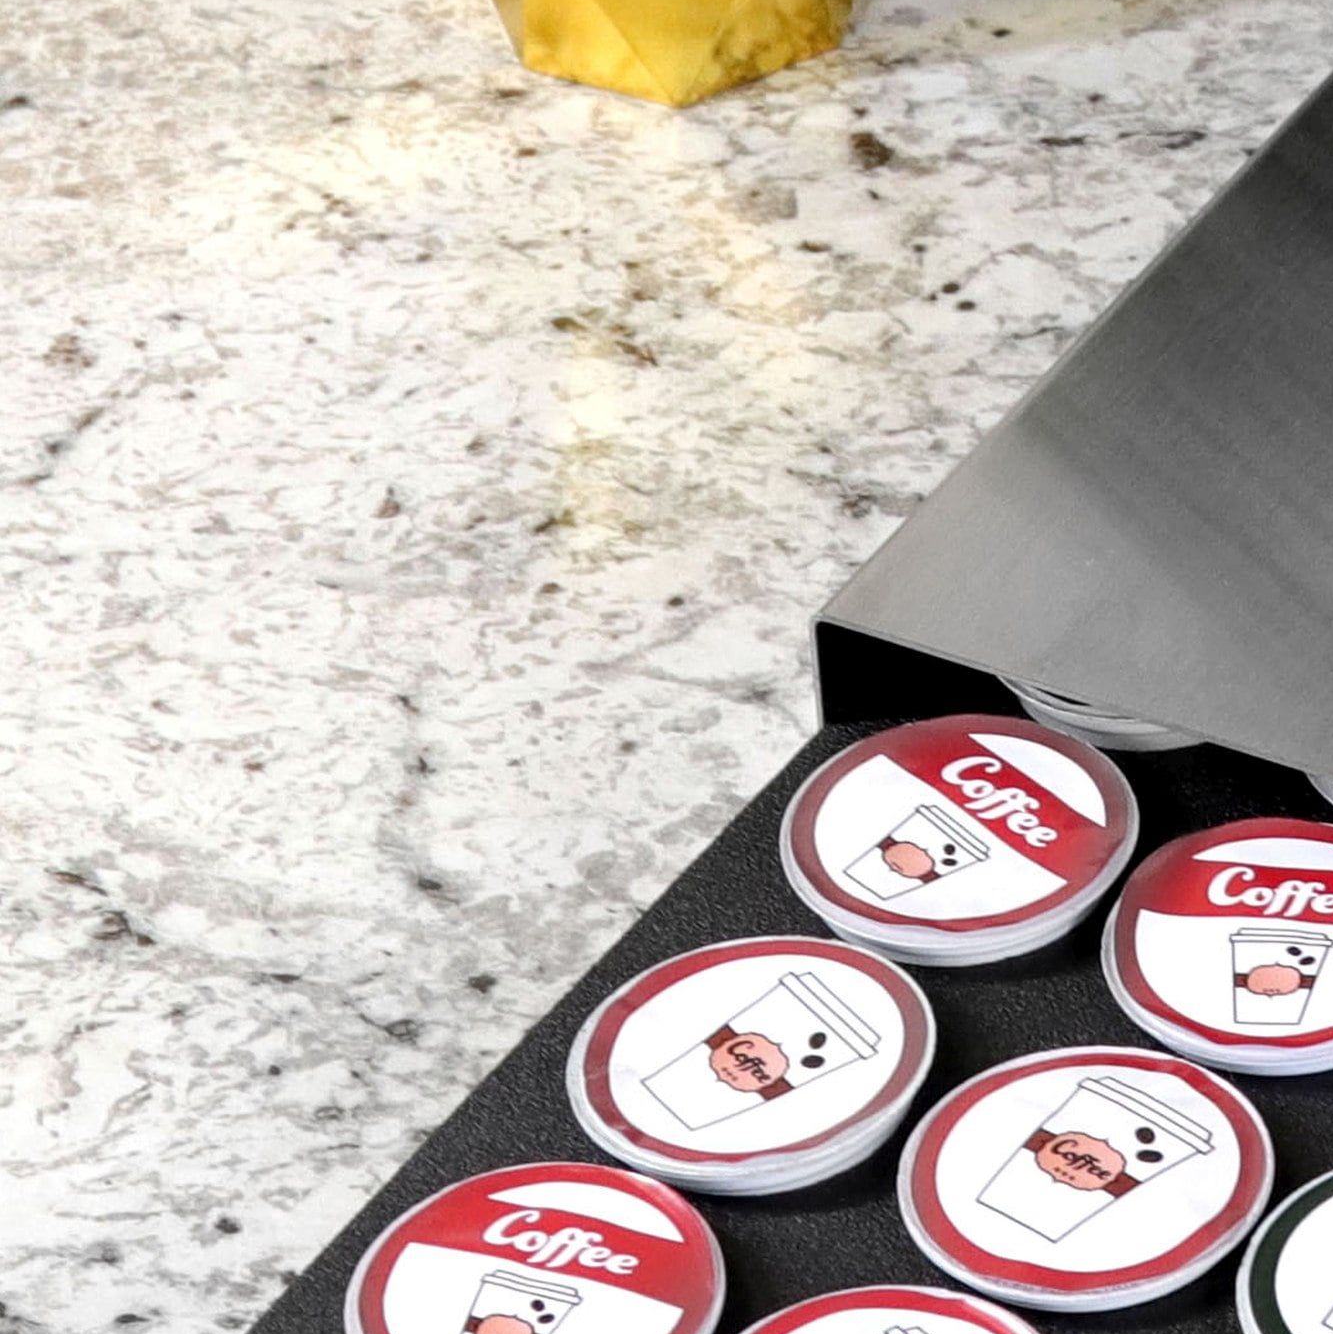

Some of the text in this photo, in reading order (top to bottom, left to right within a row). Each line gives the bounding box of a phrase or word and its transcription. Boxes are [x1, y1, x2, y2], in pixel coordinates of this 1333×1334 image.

[941, 756, 1058, 848] Coffee
[727, 1040, 771, 1083] Coffee
[1051, 1139, 1111, 1180] Coffee
[482, 1209, 639, 1275] Coffee
